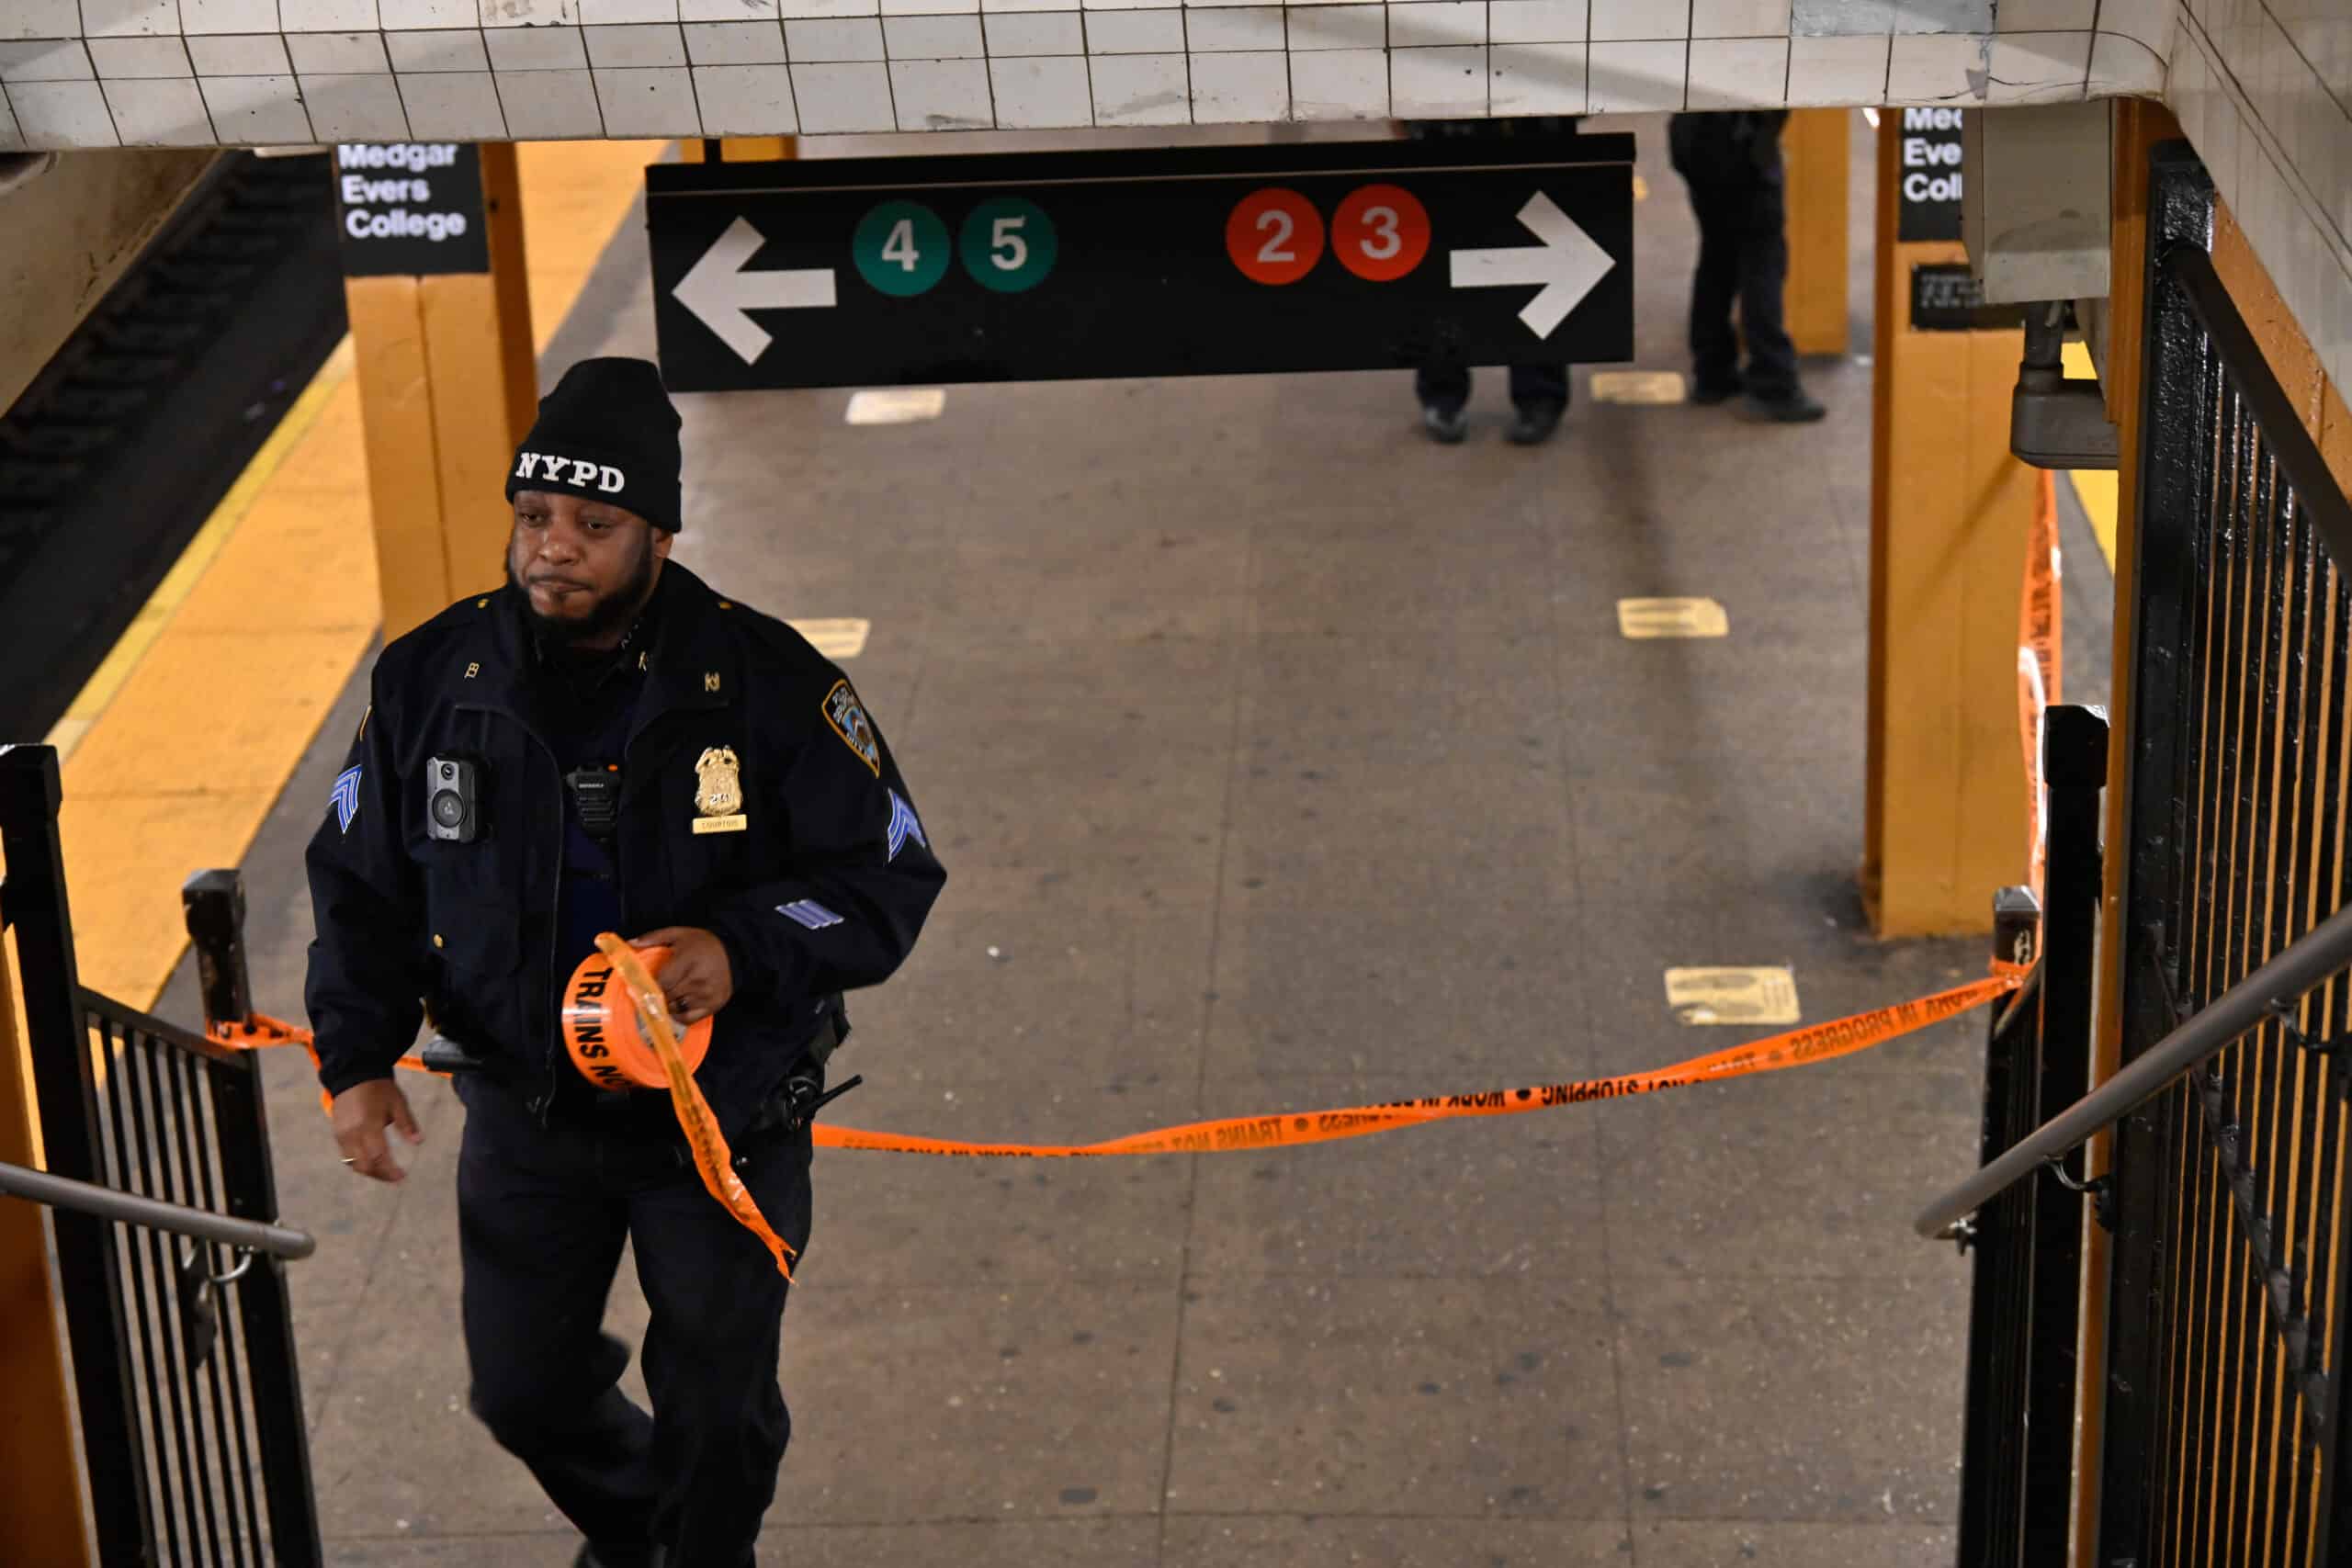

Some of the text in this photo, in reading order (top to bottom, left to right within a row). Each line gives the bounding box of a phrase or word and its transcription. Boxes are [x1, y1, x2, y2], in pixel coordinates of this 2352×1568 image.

[337, 143, 458, 172] Medgar
[341, 175, 431, 203] Evers
[345, 209, 467, 241] College
[1256, 206, 1402, 263] 2 3
[881, 215, 1027, 272] 4 5
[515, 452, 625, 492] NYPD
[573, 966, 614, 1059] TRAINS
[1541, 1079, 1639, 1106] STOPPING
